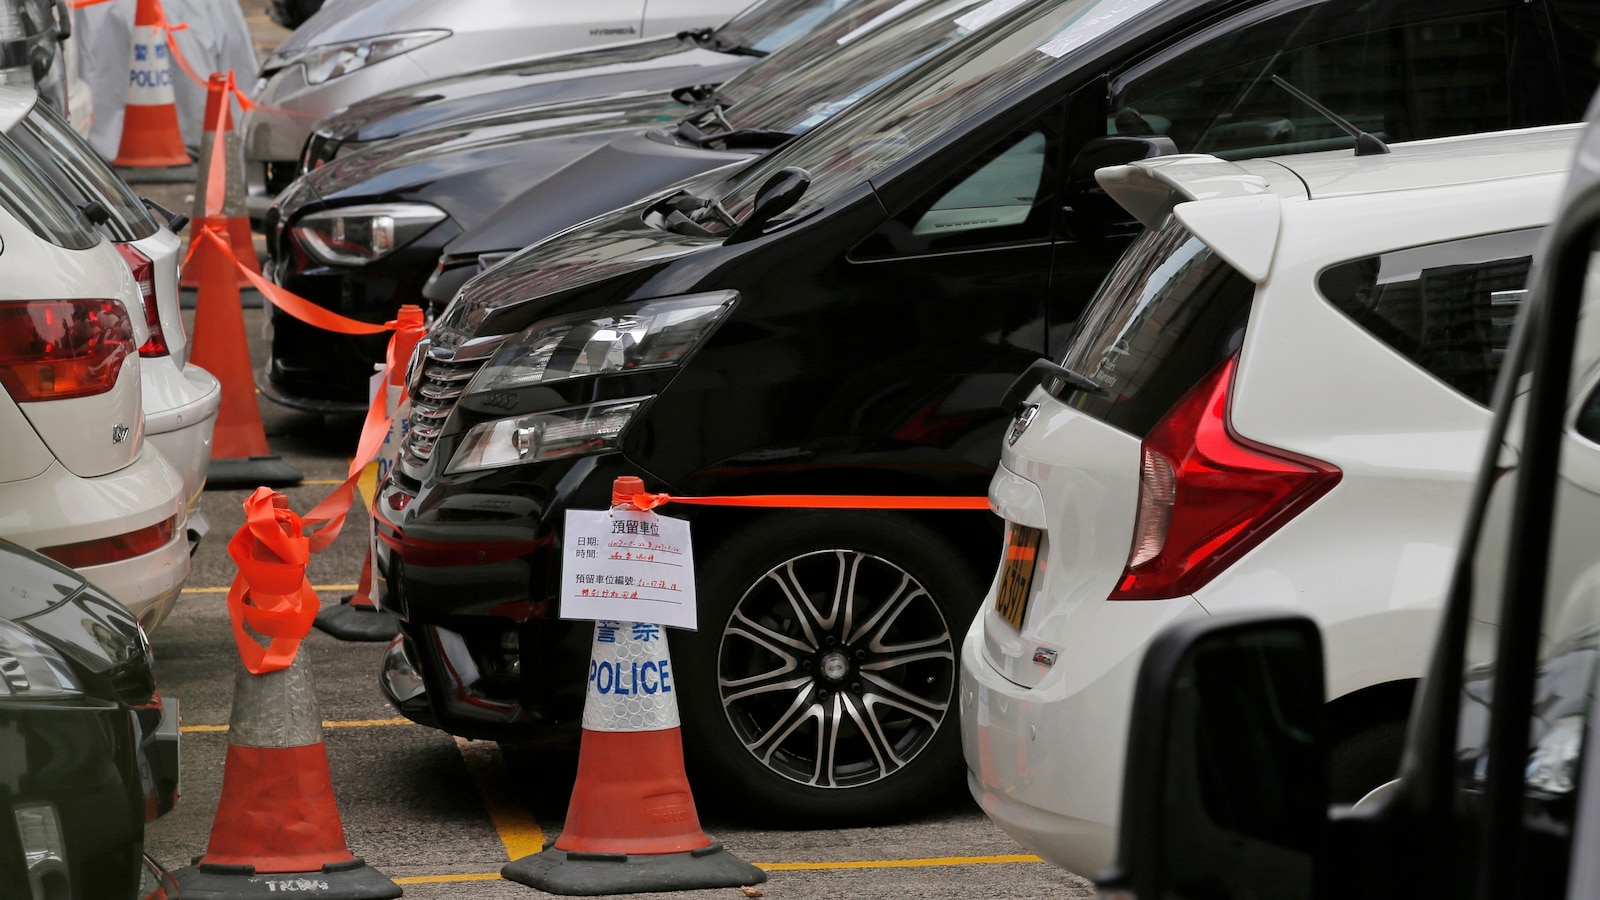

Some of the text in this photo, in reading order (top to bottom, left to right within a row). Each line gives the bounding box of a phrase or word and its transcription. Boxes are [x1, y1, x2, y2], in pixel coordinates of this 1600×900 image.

[611, 519, 660, 536] 預留車位
[577, 537, 599, 546] 日期:
[576, 549, 598, 559] 時間:
[575, 574, 636, 586] 預留車位編號:
[588, 660, 671, 695] POLICE
